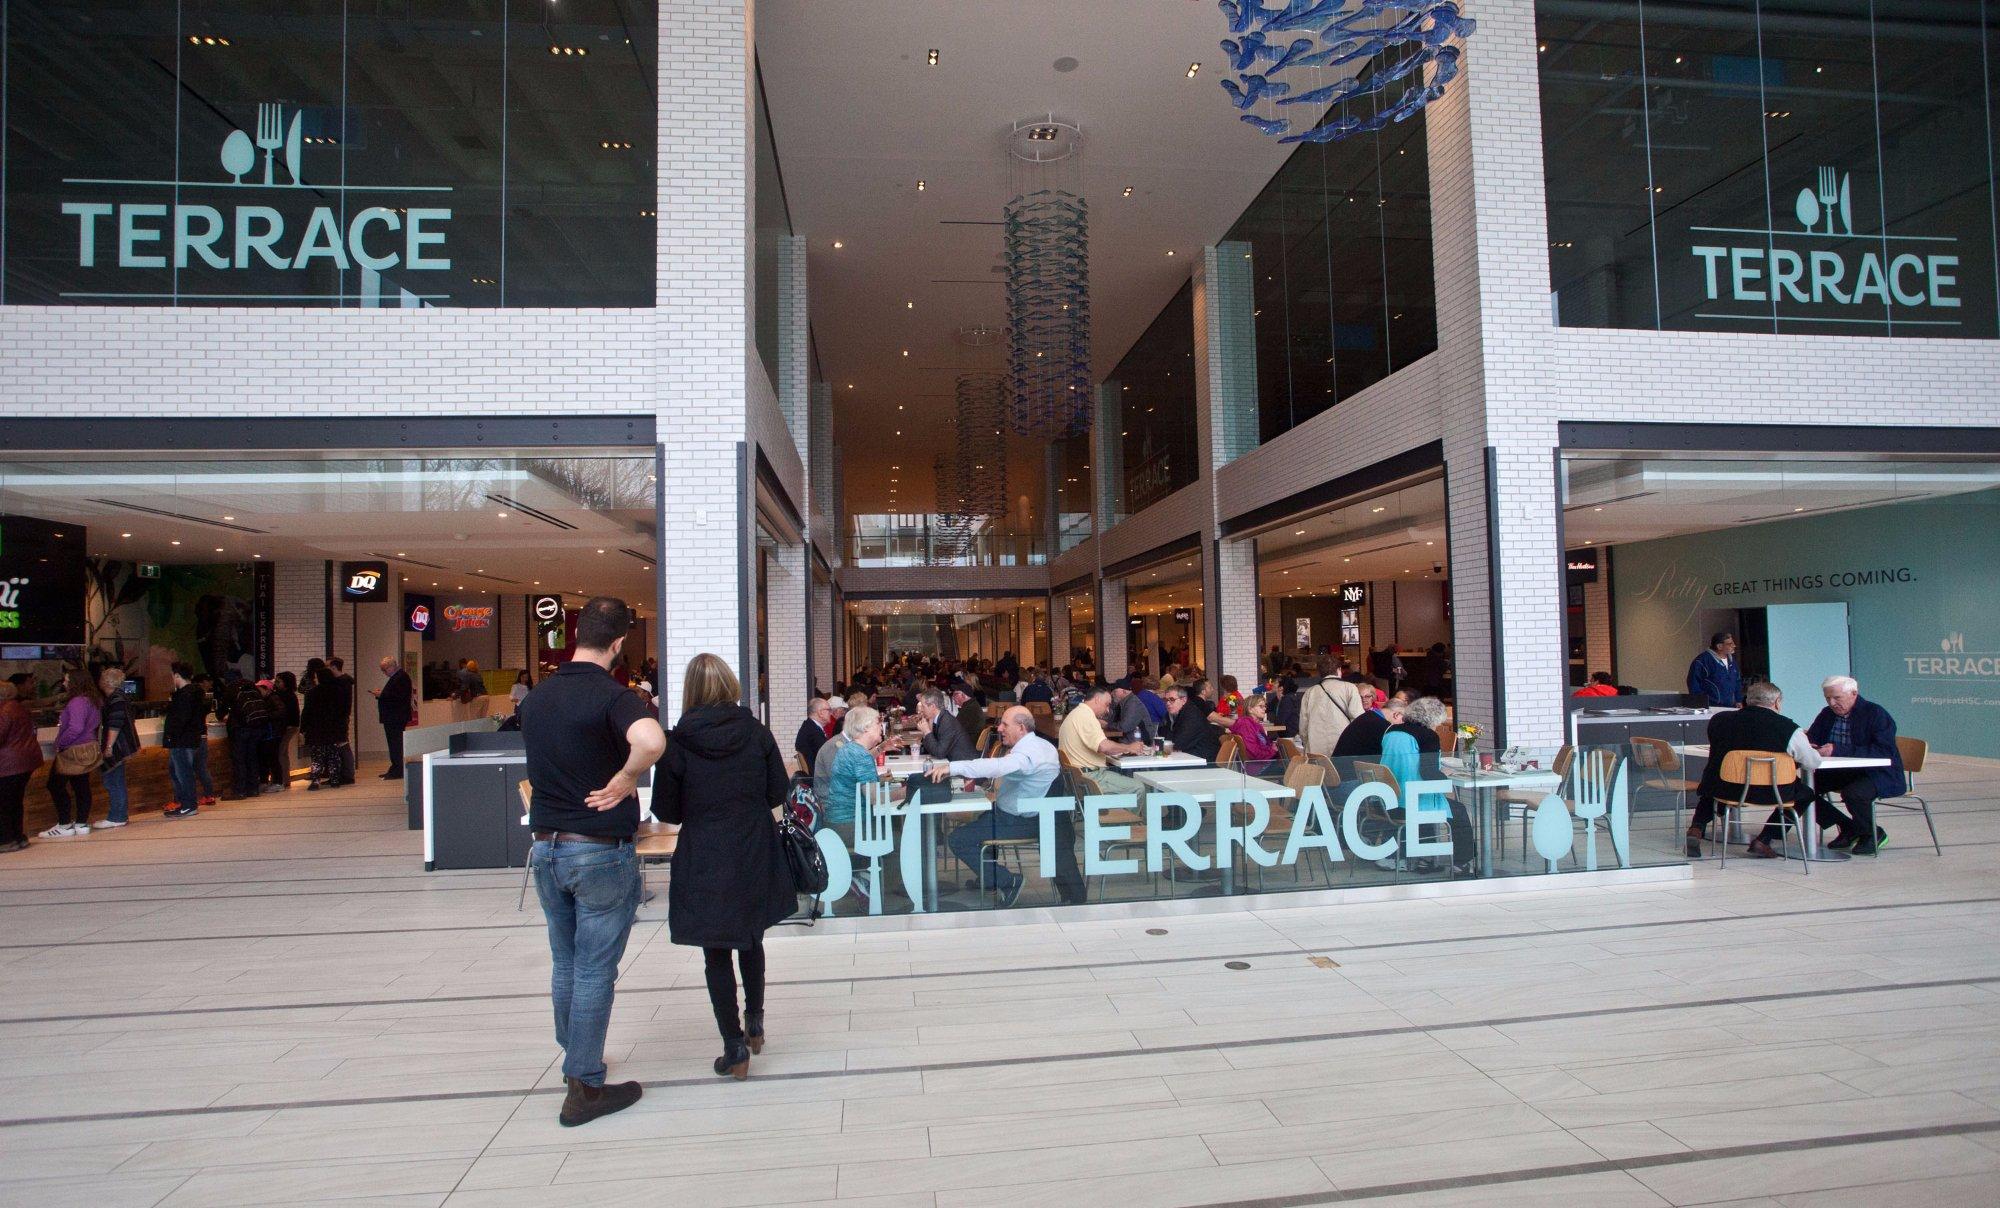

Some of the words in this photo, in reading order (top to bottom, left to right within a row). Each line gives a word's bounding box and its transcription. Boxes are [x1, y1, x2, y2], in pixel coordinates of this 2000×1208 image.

[62, 203, 451, 270] TERRACE
[1692, 246, 1961, 307] TERRACE
[350, 575, 377, 590] DQ
[1713, 580, 1758, 596] GREAT
[1763, 574, 1823, 591] THINGS
[1829, 567, 1917, 587] COMING.
[1344, 587, 1363, 602] NYF
[416, 611, 430, 625] DQ
[444, 606, 493, 619] Orange
[1017, 780, 1453, 877] TERRACE
